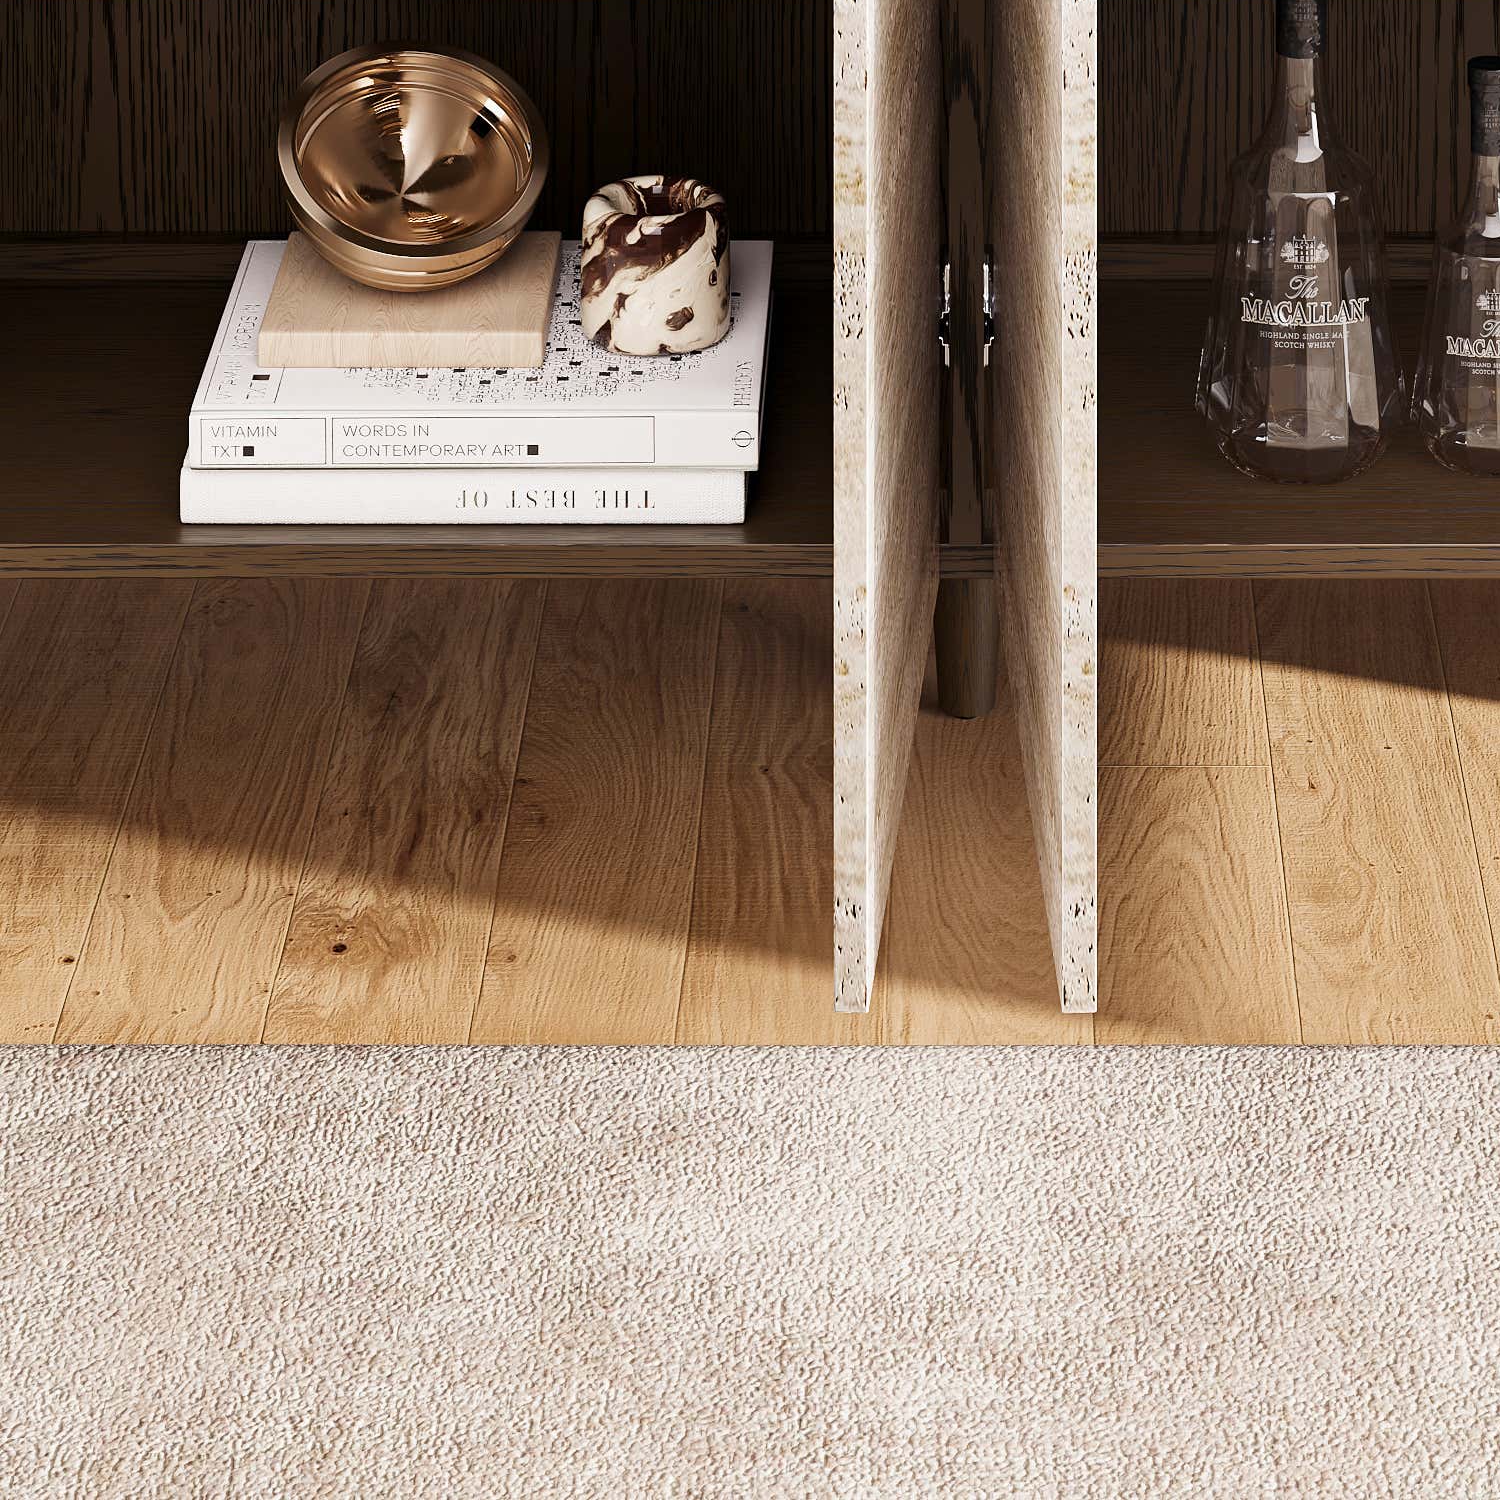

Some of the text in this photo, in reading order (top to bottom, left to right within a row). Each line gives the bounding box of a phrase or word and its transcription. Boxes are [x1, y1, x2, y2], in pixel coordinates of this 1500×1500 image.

[1284, 274, 1319, 299] The
[1241, 297, 1370, 327] MACALLAN
[1259, 330, 1300, 339] HIGHLAND
[1302, 332, 1330, 340] SINGLE
[1274, 341, 1305, 349] SCOTCH
[211, 425, 278, 438] VITAMIN
[342, 424, 430, 438] WORDS IN
[211, 444, 240, 458] TXT
[342, 444, 525, 457] CONTEMPORARY ART
[455, 489, 656, 508] THE BEST OF
